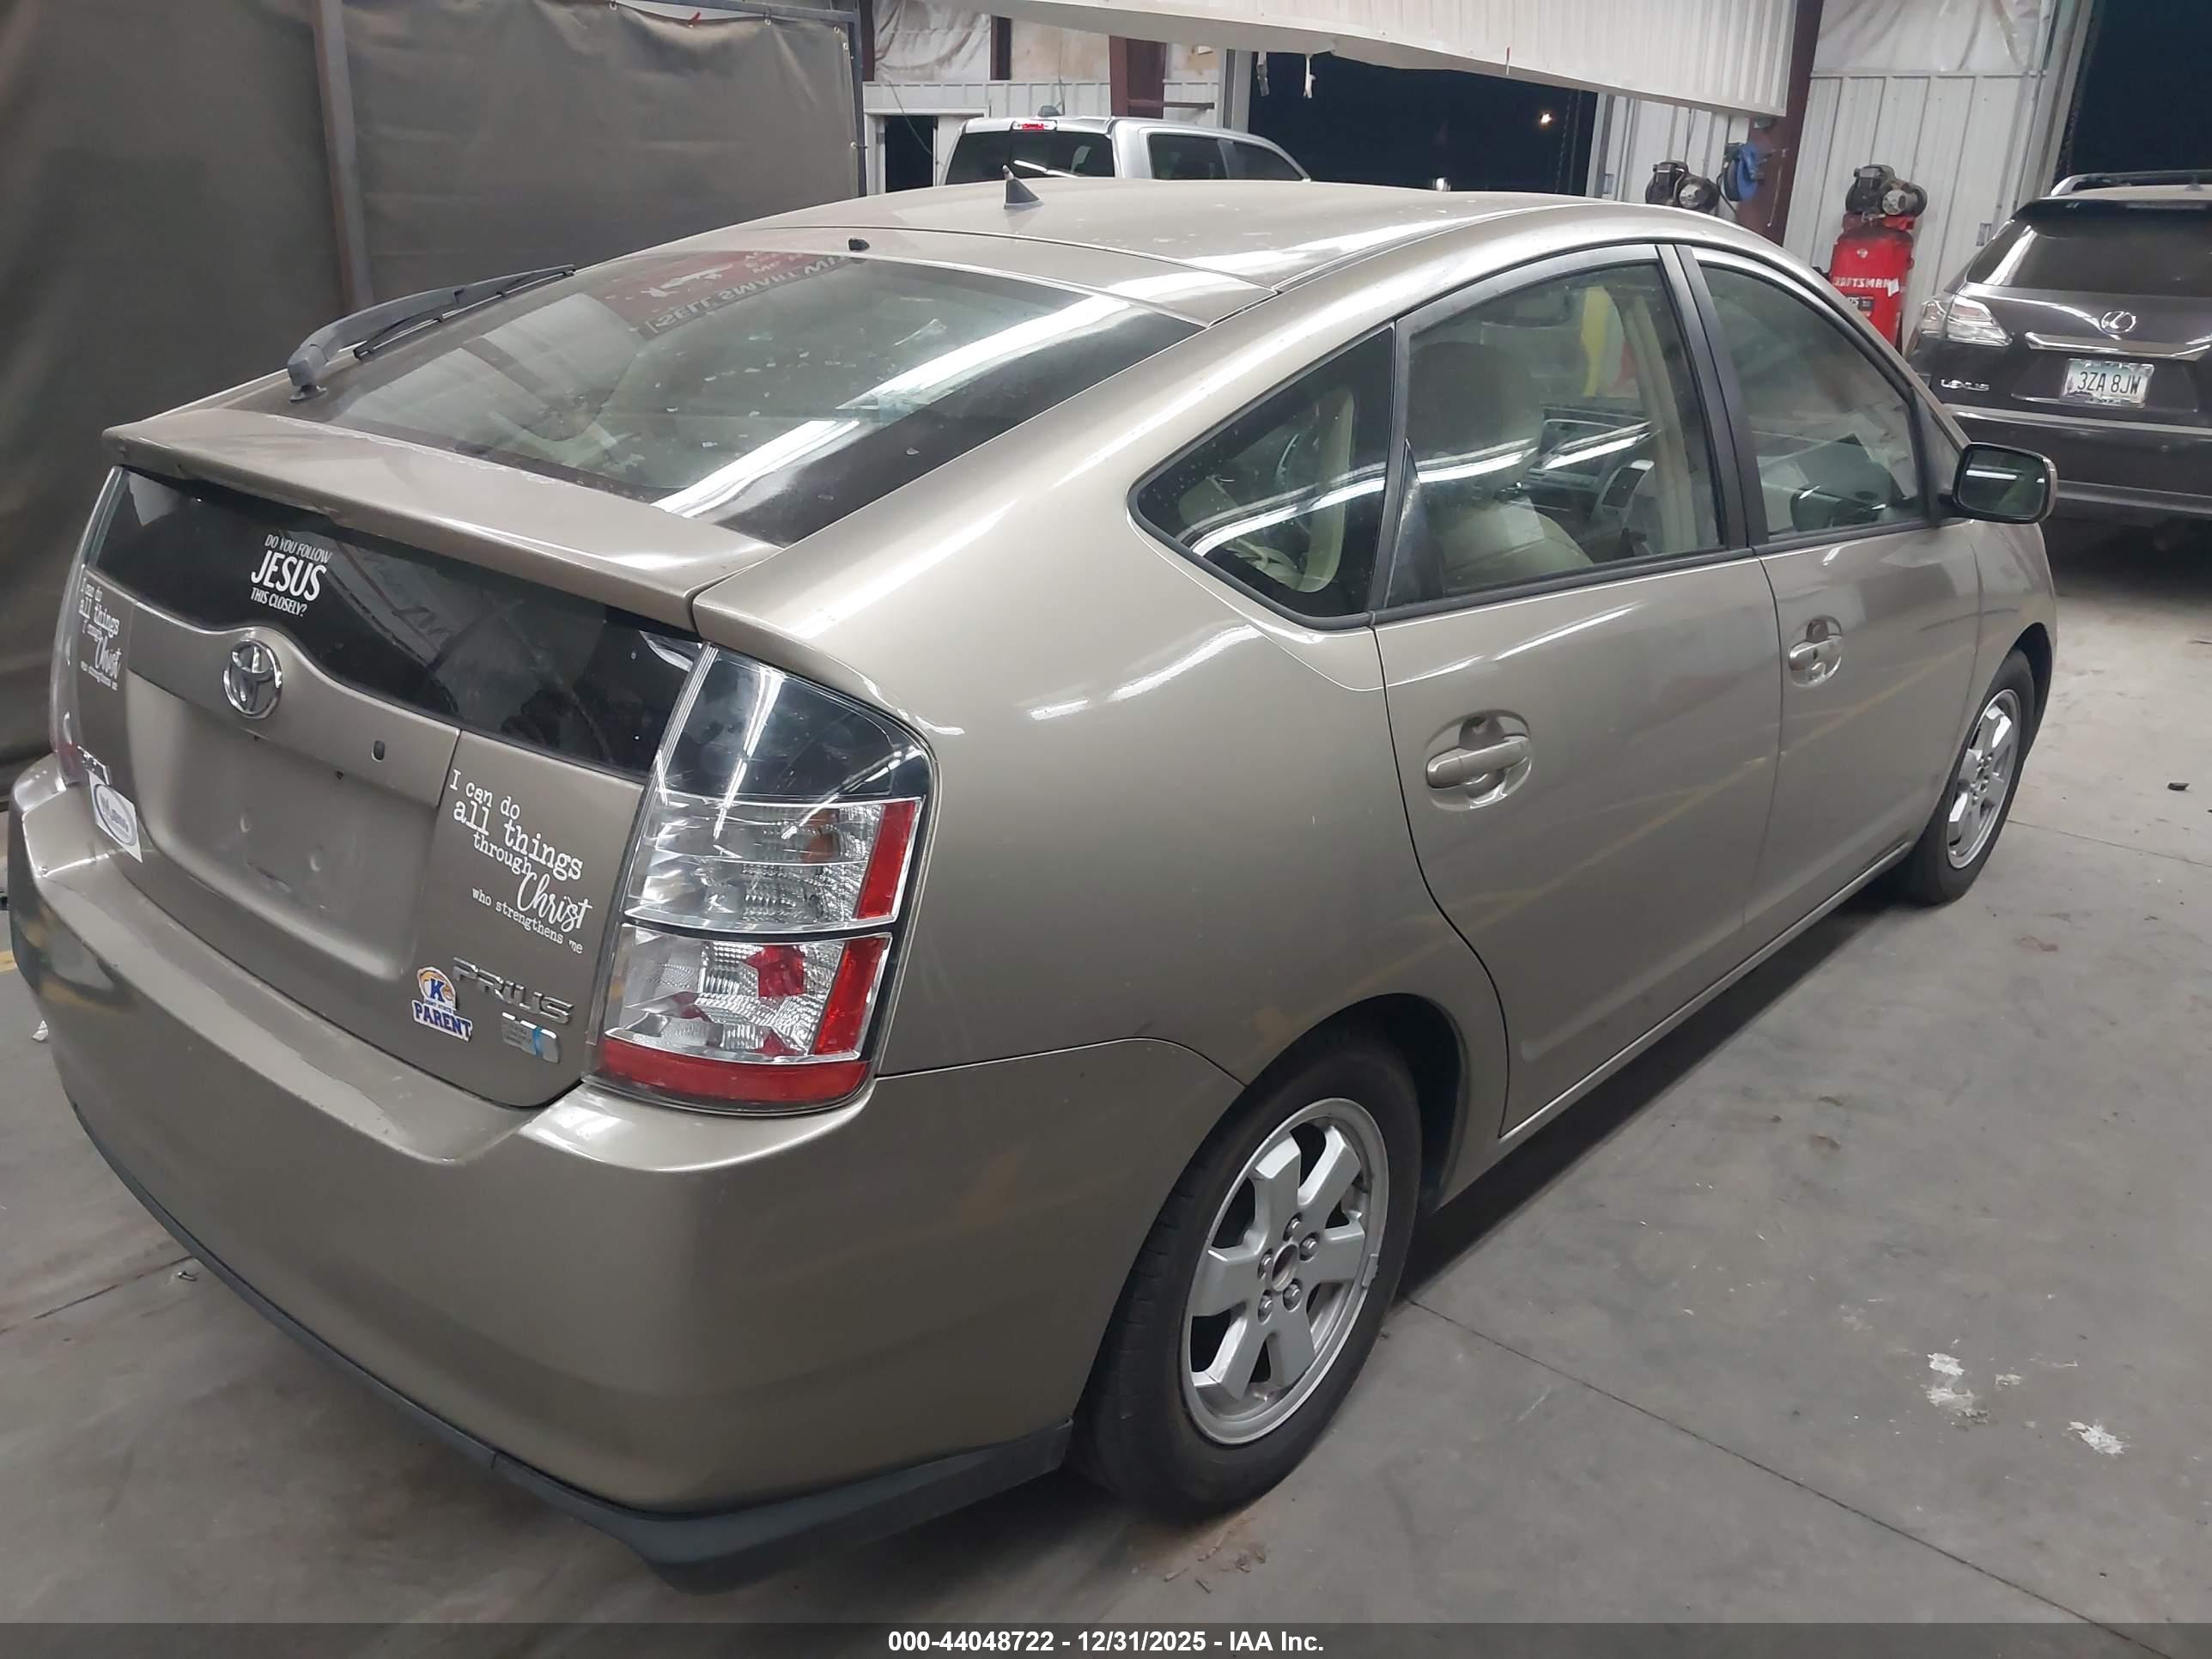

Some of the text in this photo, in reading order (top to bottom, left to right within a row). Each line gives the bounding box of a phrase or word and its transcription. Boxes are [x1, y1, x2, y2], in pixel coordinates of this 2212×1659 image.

[2077, 371, 2141, 394] 3ZA 8JW
[264, 534, 333, 563] DO YOU FOLLOW
[251, 550, 327, 601] JESUS
[251, 586, 307, 617] THIS CLOSELY?
[449, 769, 520, 819] I can do
[453, 800, 583, 881] all things
[473, 831, 532, 875] through
[472, 887, 492, 907] who
[495, 901, 563, 944] strengthens
[517, 872, 593, 933] Christ
[429, 977, 446, 1003] K
[453, 957, 574, 1024] PRIUS
[414, 1001, 471, 1040] PARENT
